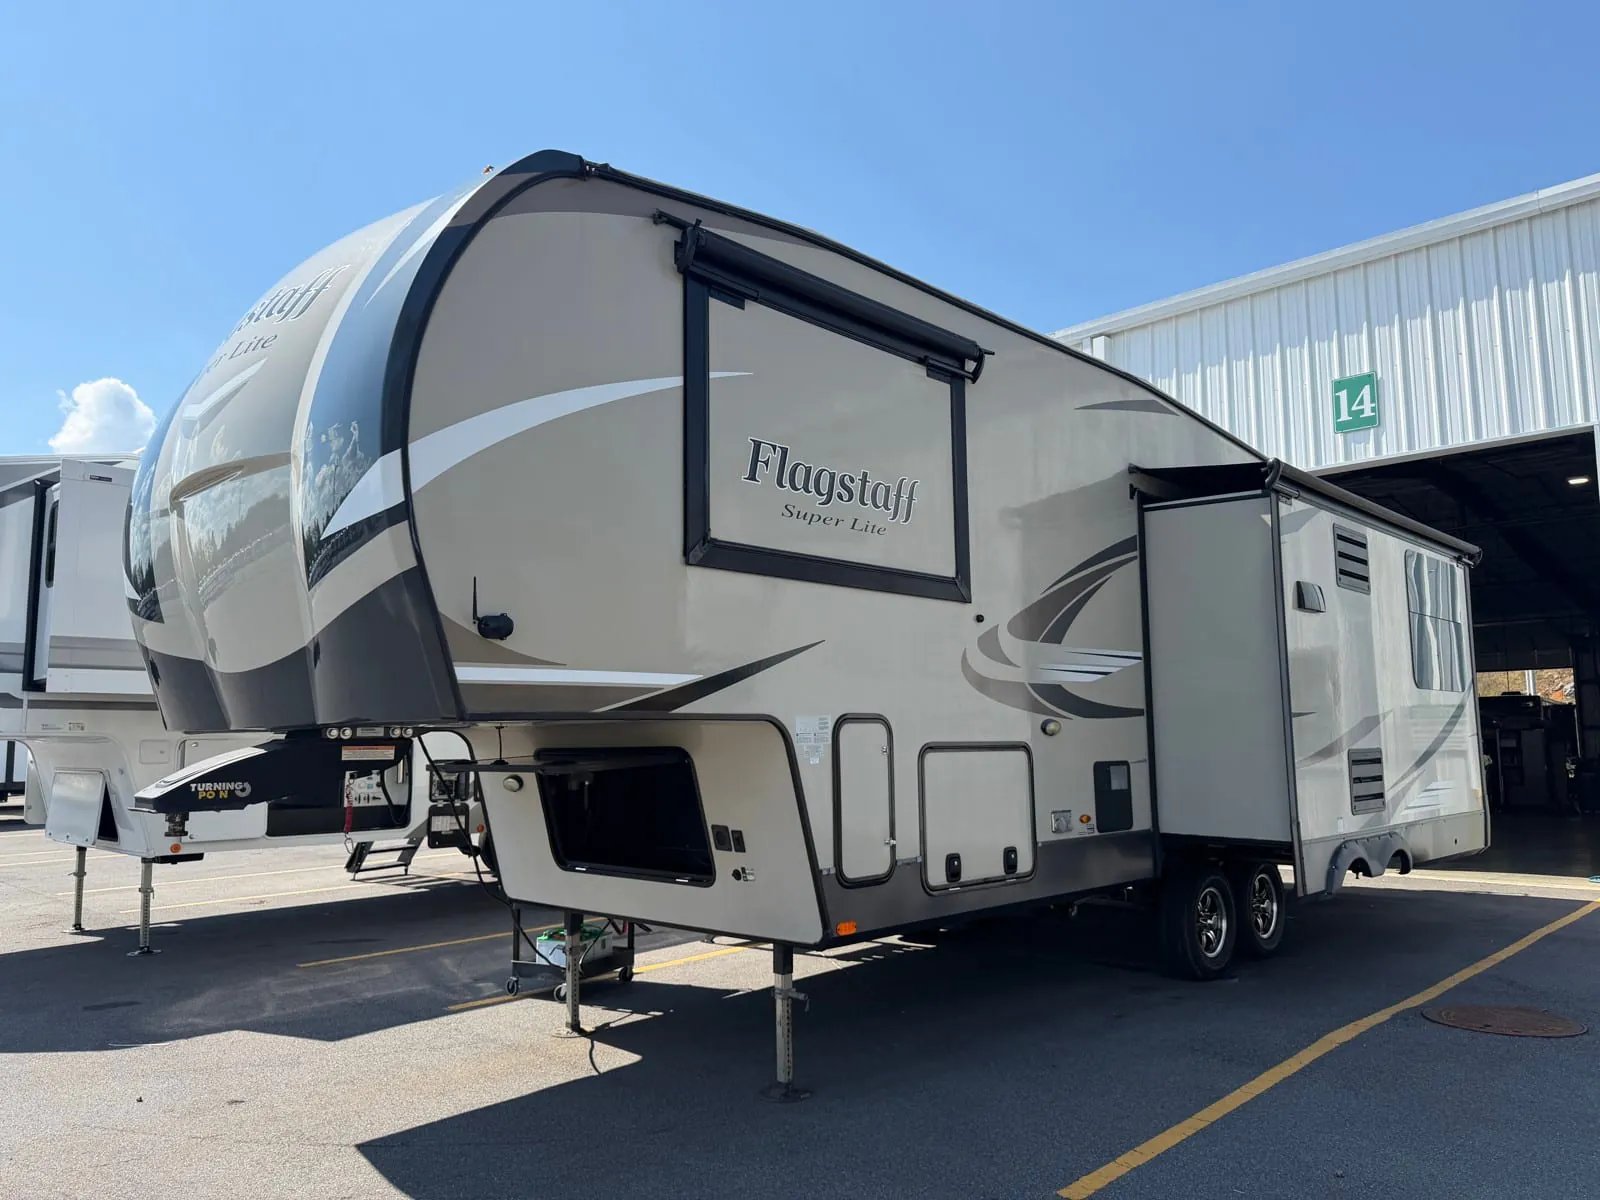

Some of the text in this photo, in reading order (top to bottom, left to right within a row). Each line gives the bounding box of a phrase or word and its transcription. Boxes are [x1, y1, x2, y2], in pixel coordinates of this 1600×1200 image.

[228, 334, 278, 361] Lite
[1335, 384, 1376, 422] 14
[742, 436, 919, 524] Flagstaff
[781, 503, 887, 536] Super Lite
[190, 782, 243, 792] TURNING
